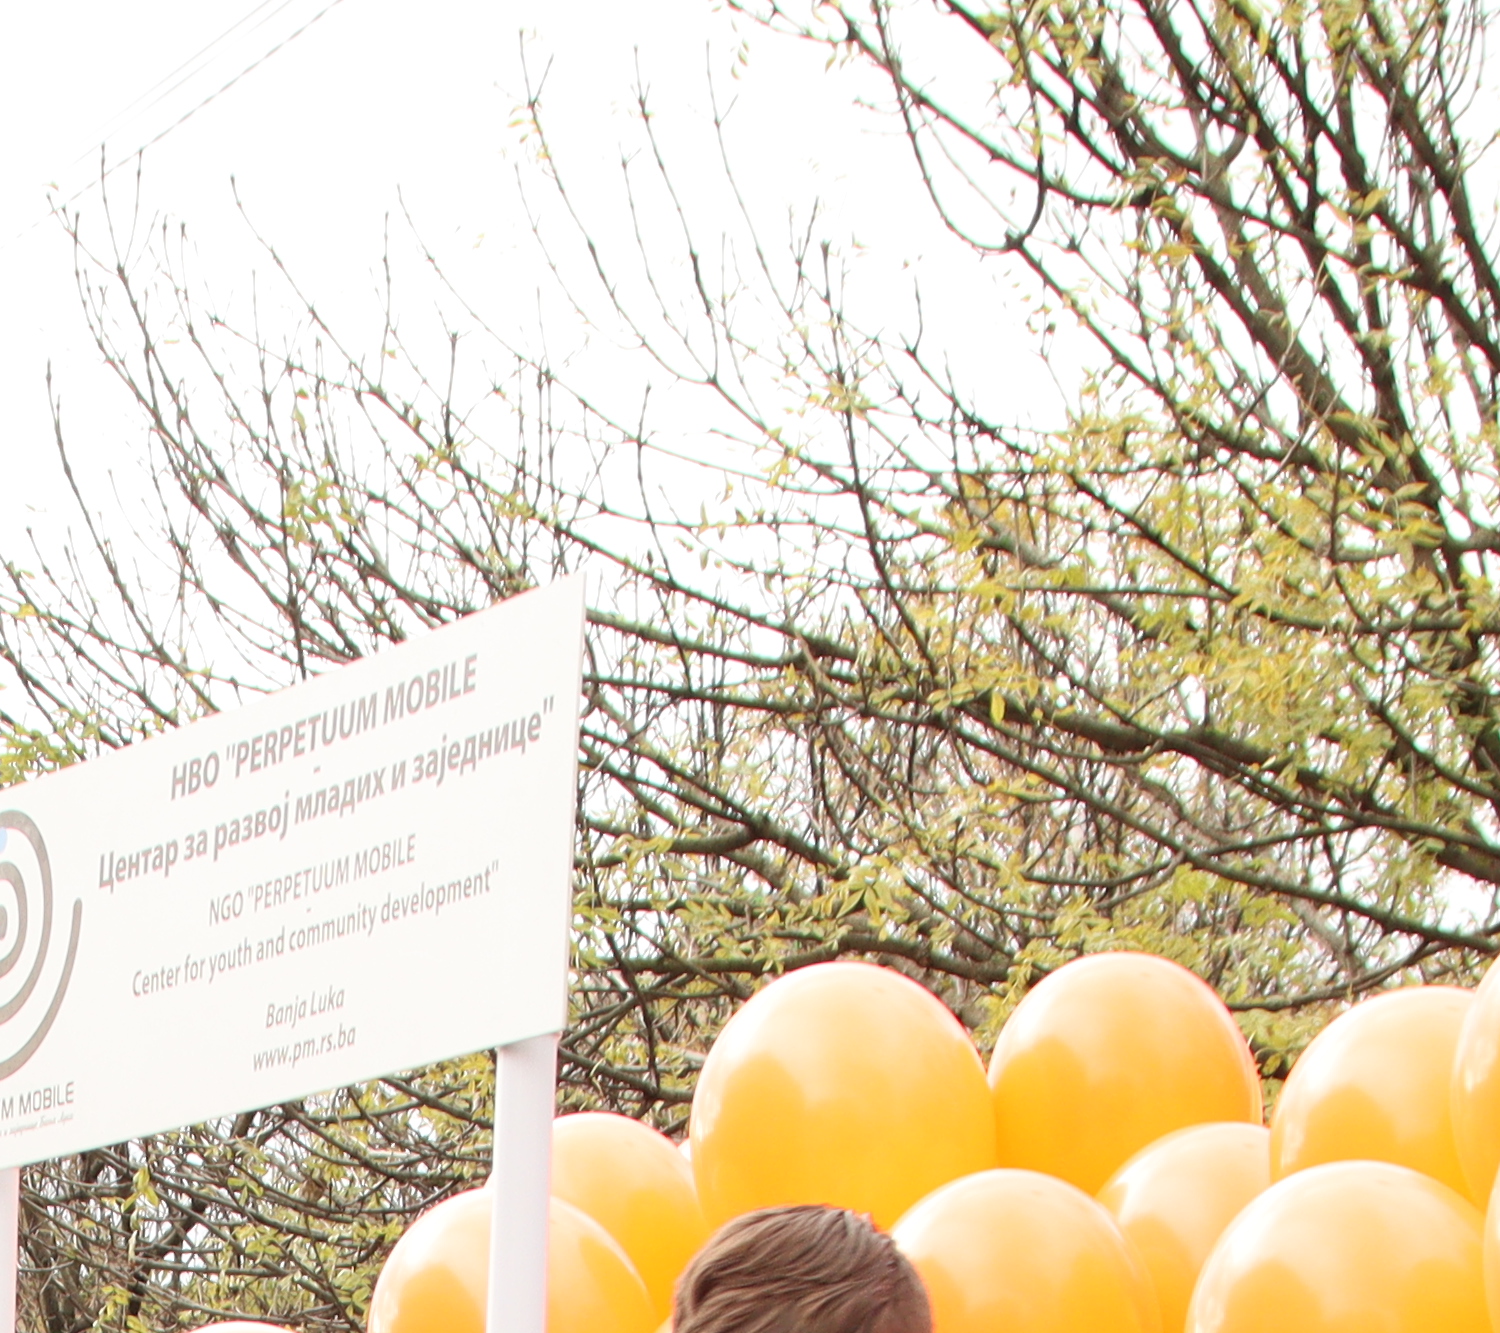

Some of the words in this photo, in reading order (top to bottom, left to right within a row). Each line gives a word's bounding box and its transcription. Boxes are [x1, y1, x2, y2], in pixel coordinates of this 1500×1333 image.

[170, 751, 220, 801] НВО
[225, 691, 378, 778] "PERPETUUM
[383, 653, 478, 725] MOBILE
[99, 839, 178, 894] Центар
[183, 829, 208, 861] за
[212, 790, 291, 862] развој
[294, 767, 386, 825] младих
[391, 760, 406, 791] и
[411, 694, 555, 787] заједнице"
[208, 890, 244, 927] NGO
[247, 856, 350, 912] "PERPETUUM
[353, 833, 416, 882] MOBILE
[132, 963, 180, 997] Center
[184, 953, 205, 984] for
[208, 937, 252, 984] youth
[256, 925, 285, 961] and
[288, 902, 377, 951] community
[380, 859, 499, 924] development"
[252, 1023, 356, 1072] www.pm.rs.ba
[265, 997, 306, 1029] Banja
[310, 984, 345, 1015] Luka
[18, 1081, 75, 1116] MOBILE
